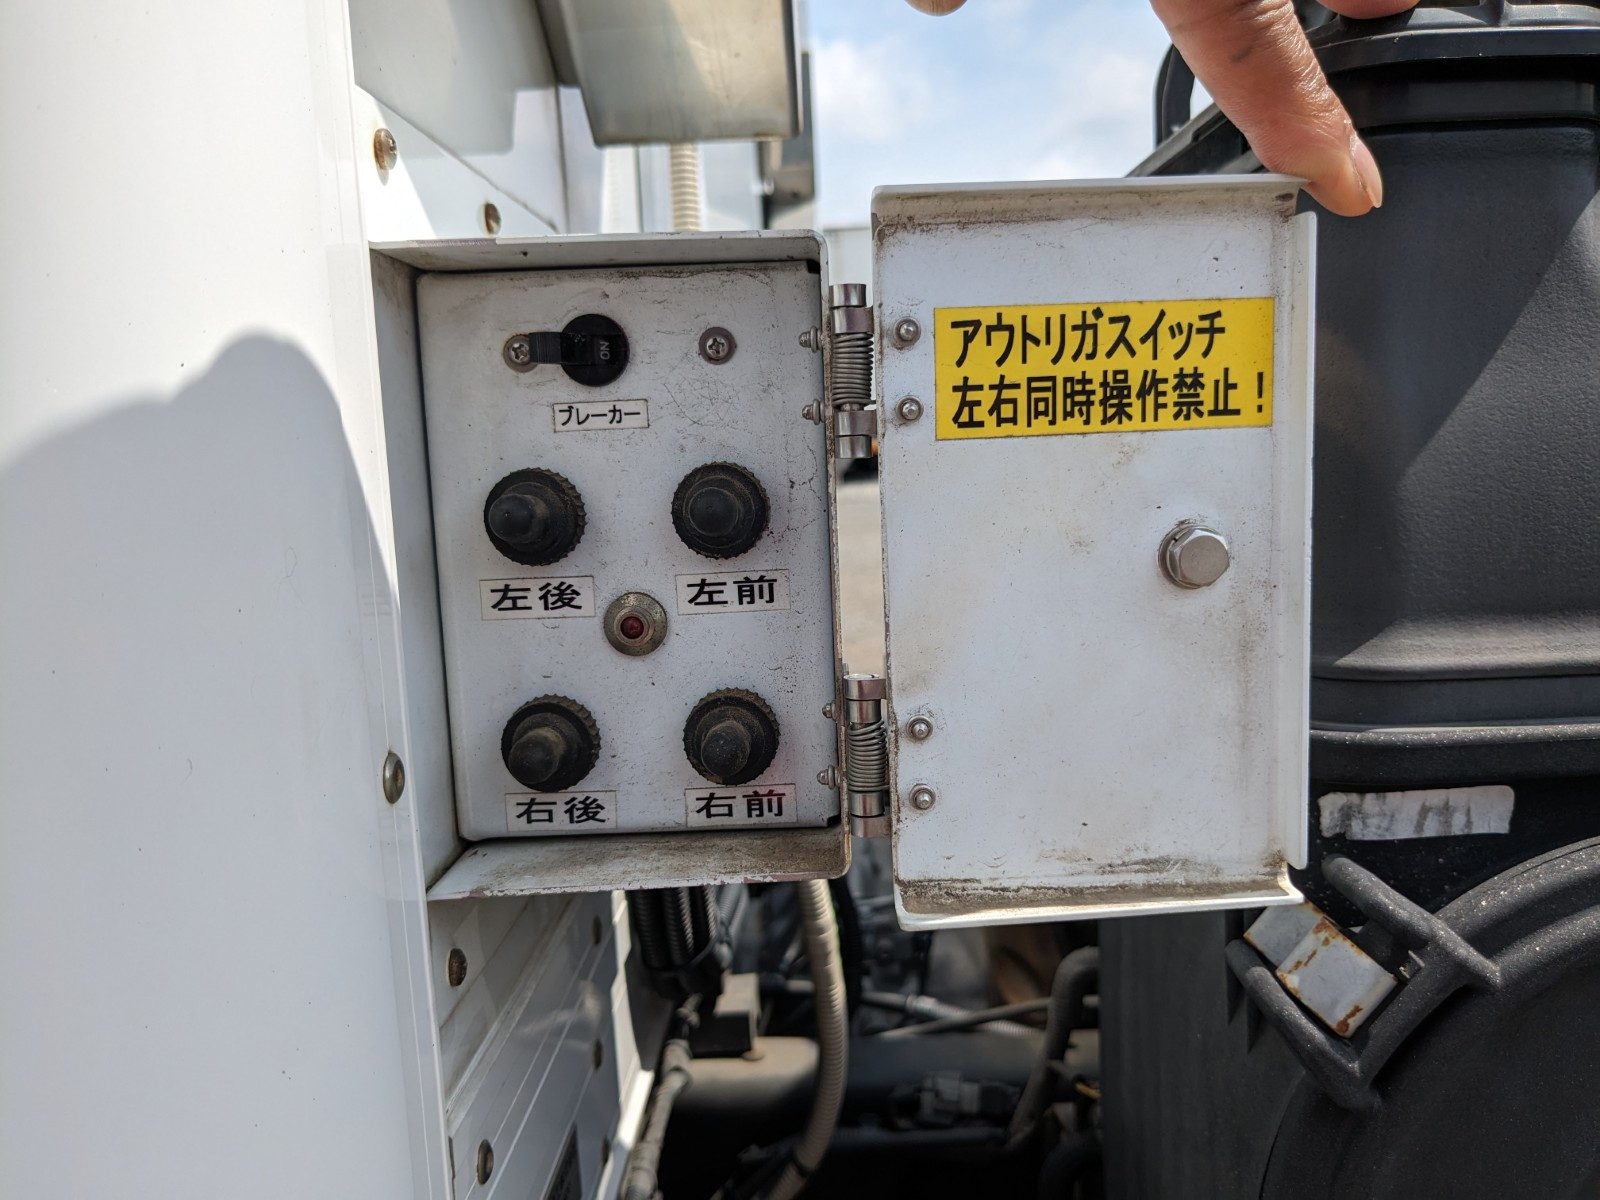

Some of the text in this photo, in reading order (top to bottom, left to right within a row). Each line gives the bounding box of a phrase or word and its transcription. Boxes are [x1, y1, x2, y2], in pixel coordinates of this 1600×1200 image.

[599, 341, 610, 360] ON
[950, 306, 1226, 368] アウトリガスイッチ
[951, 366, 1265, 430] 左右同時操作禁止！
[558, 404, 641, 427] ブレーカー
[490, 581, 583, 612] 左後
[686, 574, 778, 607] 左前
[515, 795, 606, 825] 右後
[695, 789, 787, 819] 右前
